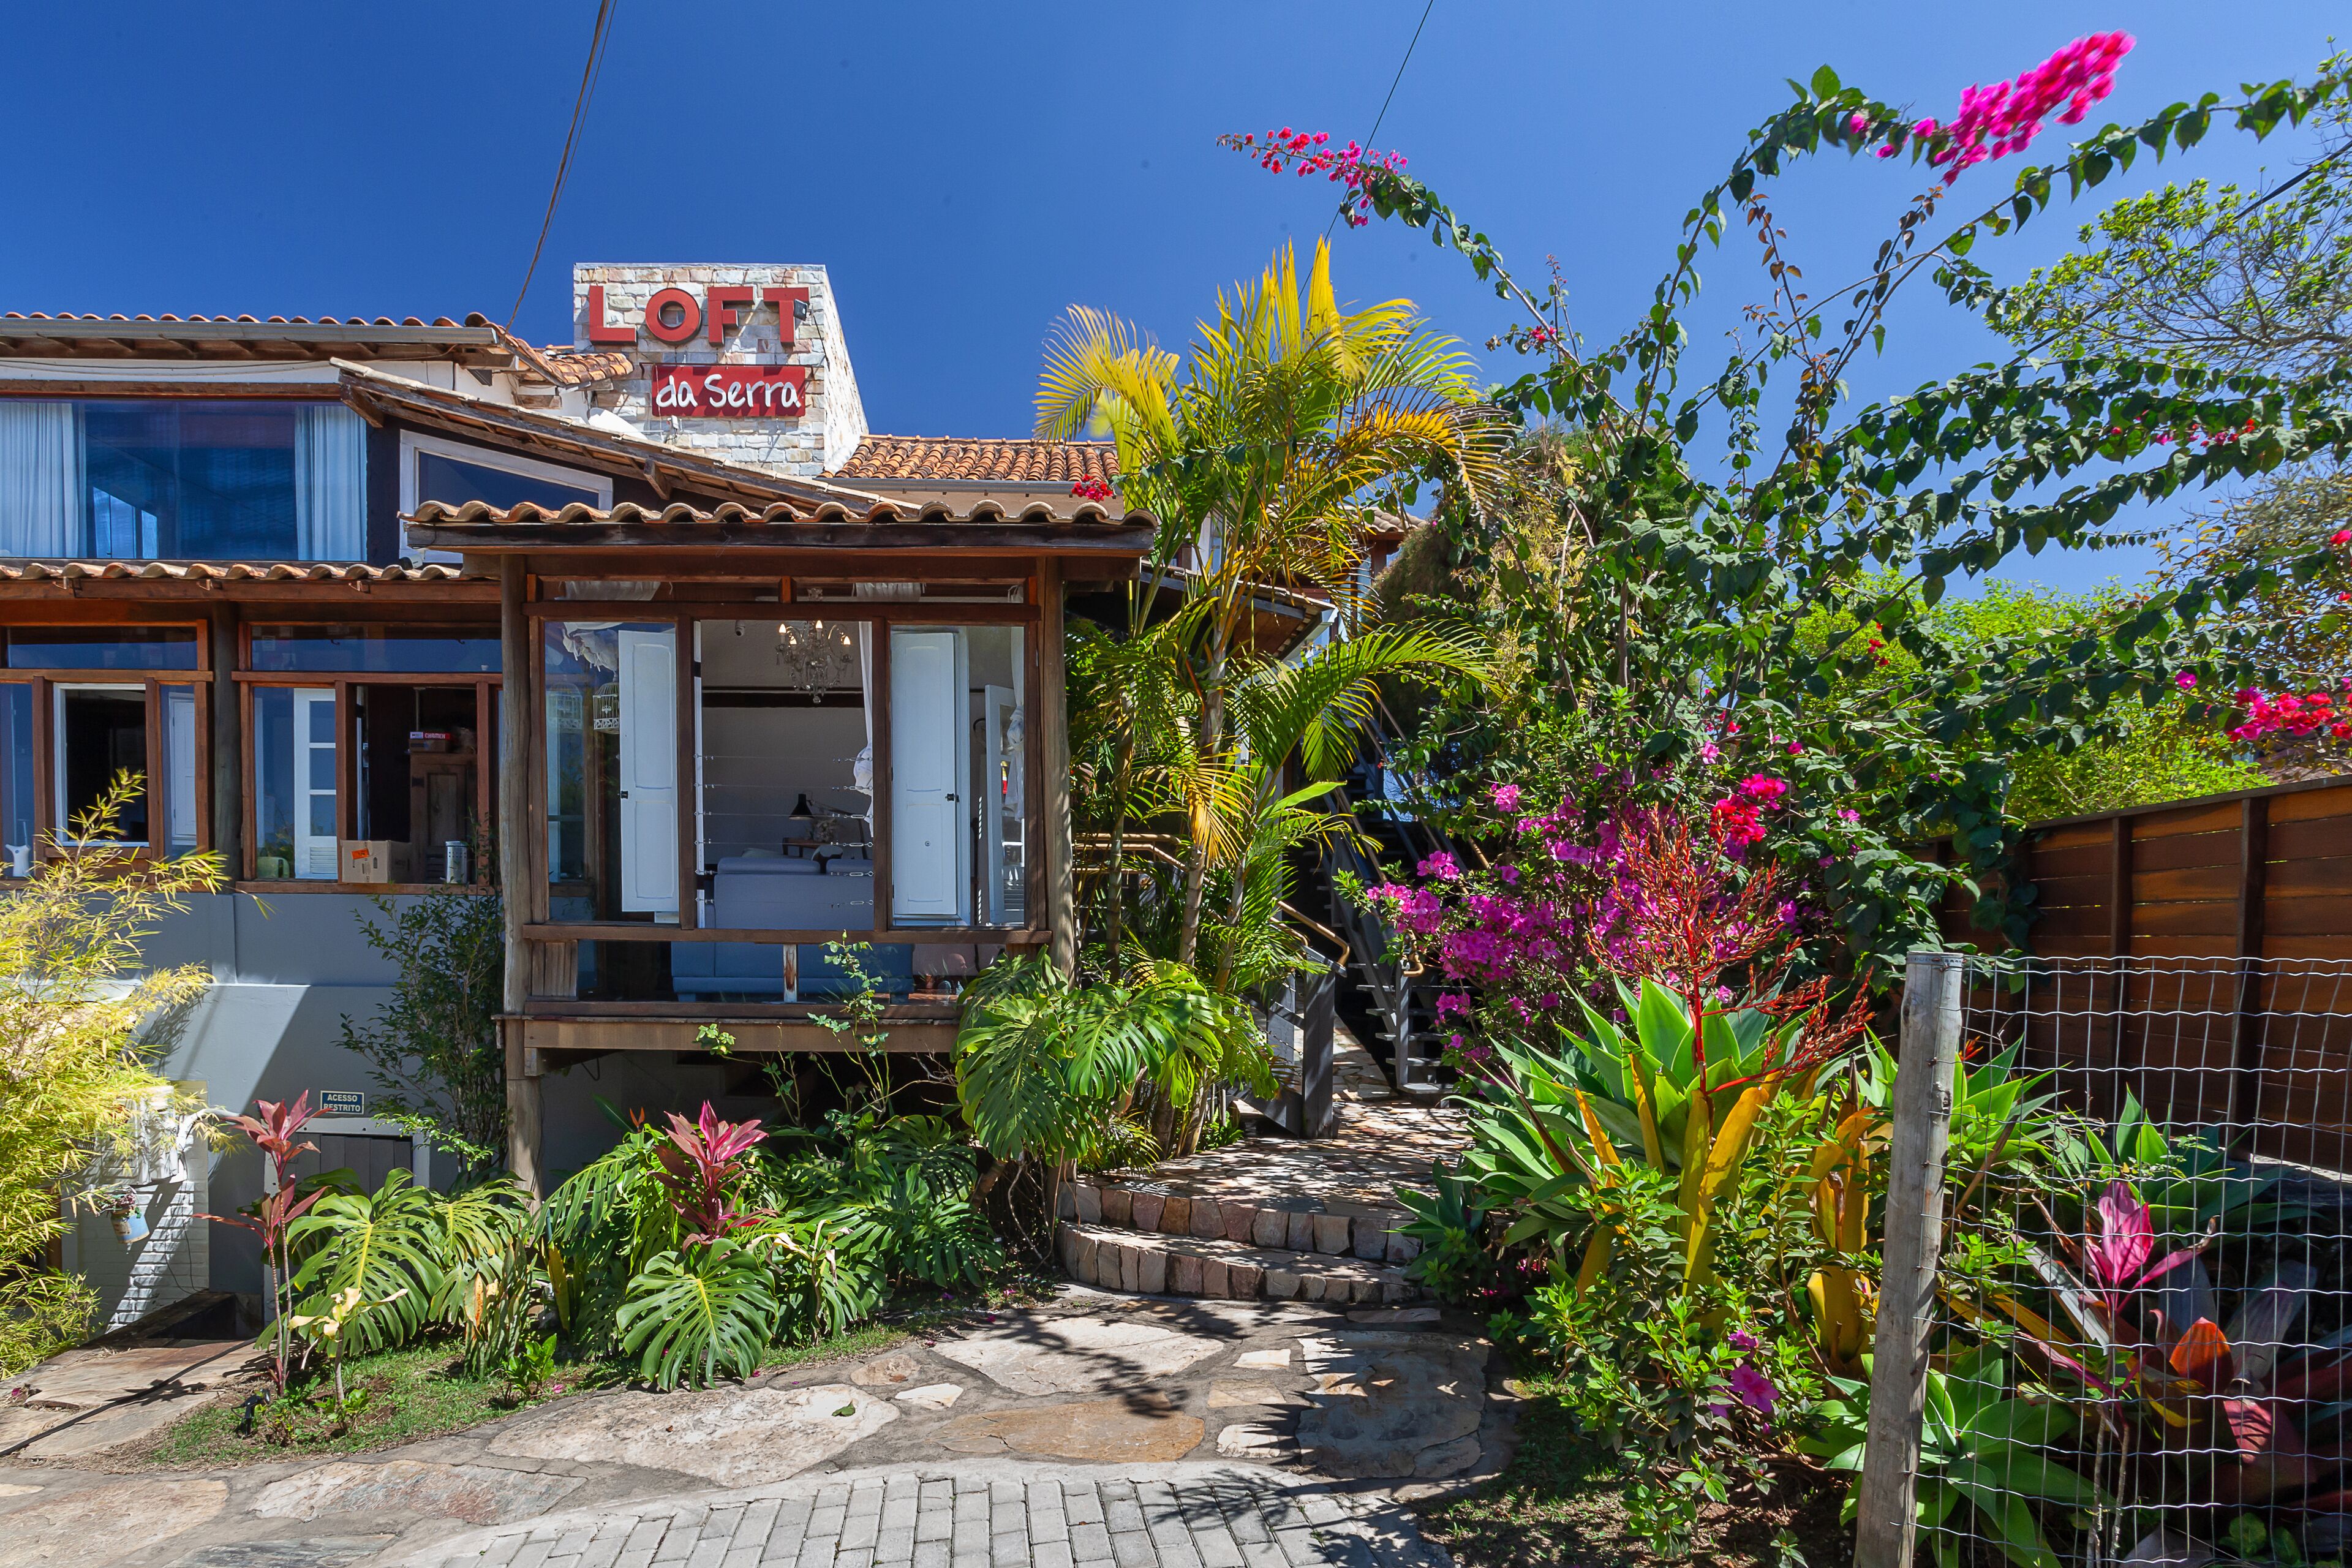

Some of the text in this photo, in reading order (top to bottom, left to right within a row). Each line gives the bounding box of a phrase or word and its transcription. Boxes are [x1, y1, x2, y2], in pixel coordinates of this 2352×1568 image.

[589, 285, 809, 346] LOFT
[656, 374, 801, 409] da Serra
